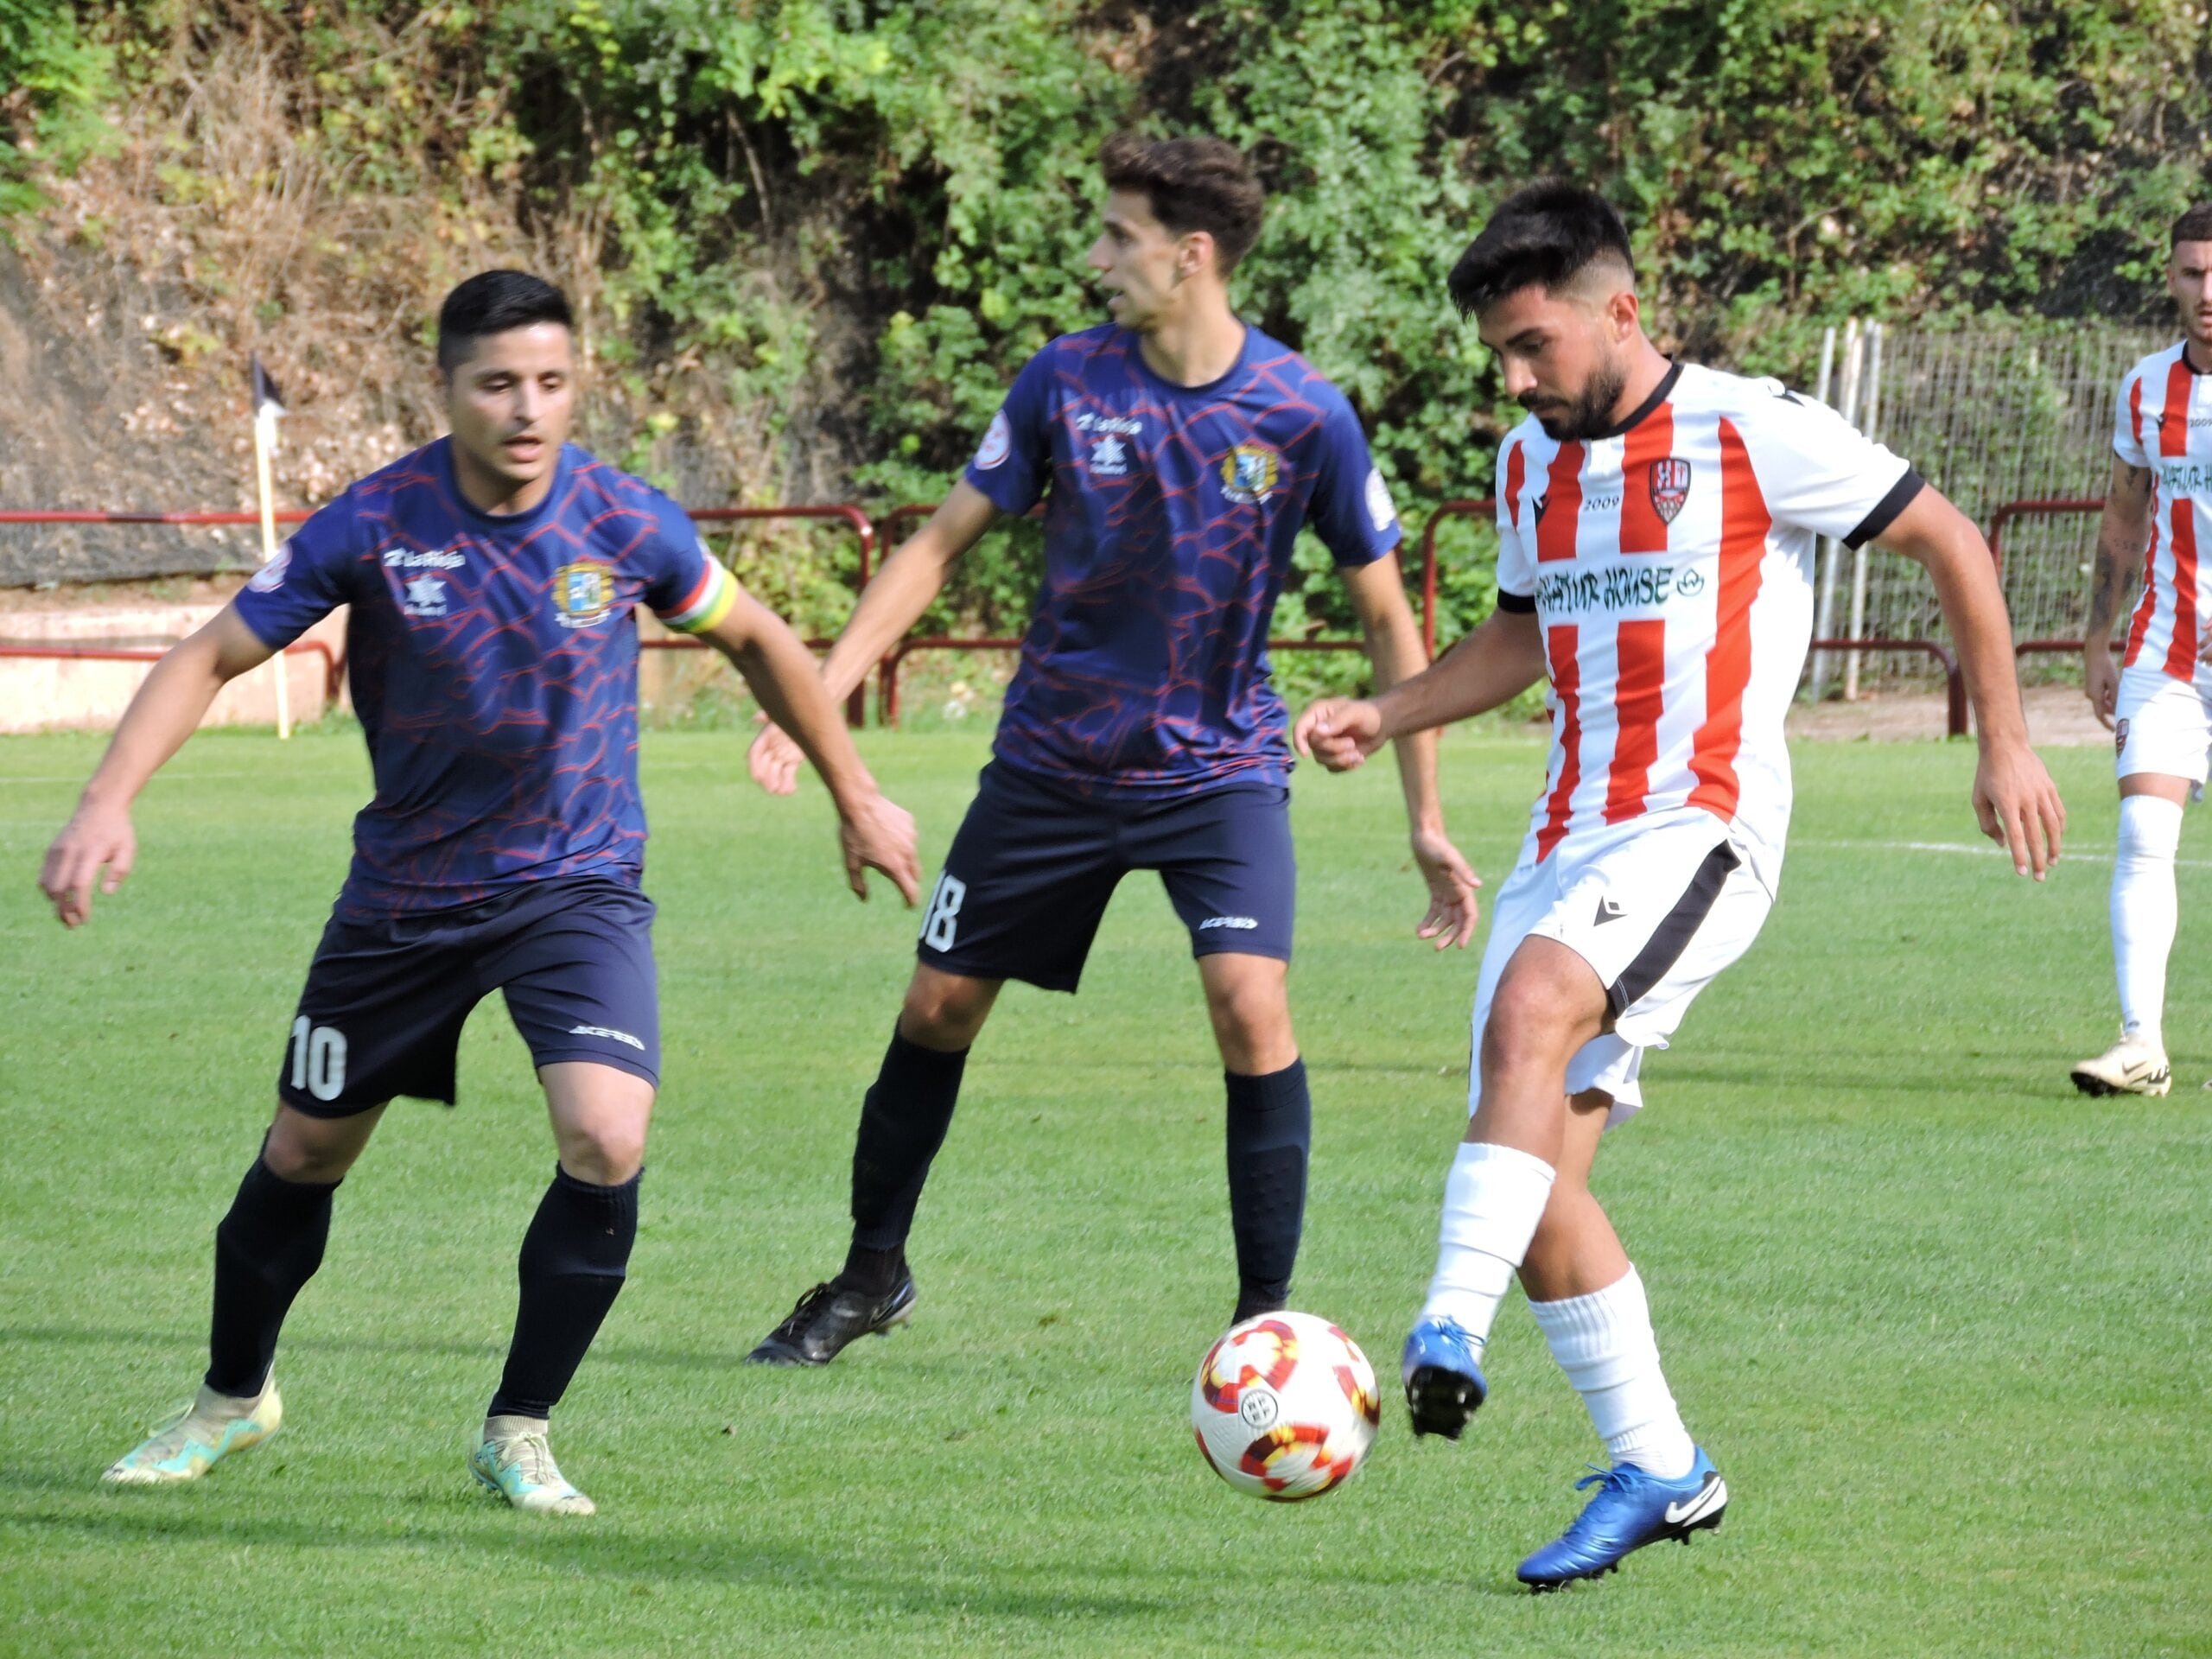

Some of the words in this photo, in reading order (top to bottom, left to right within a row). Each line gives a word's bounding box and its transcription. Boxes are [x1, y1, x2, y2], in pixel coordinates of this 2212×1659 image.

[1584, 496, 1620, 512] 2009
[1604, 566, 1675, 611] HOUSE
[289, 1014, 348, 1102] 10
